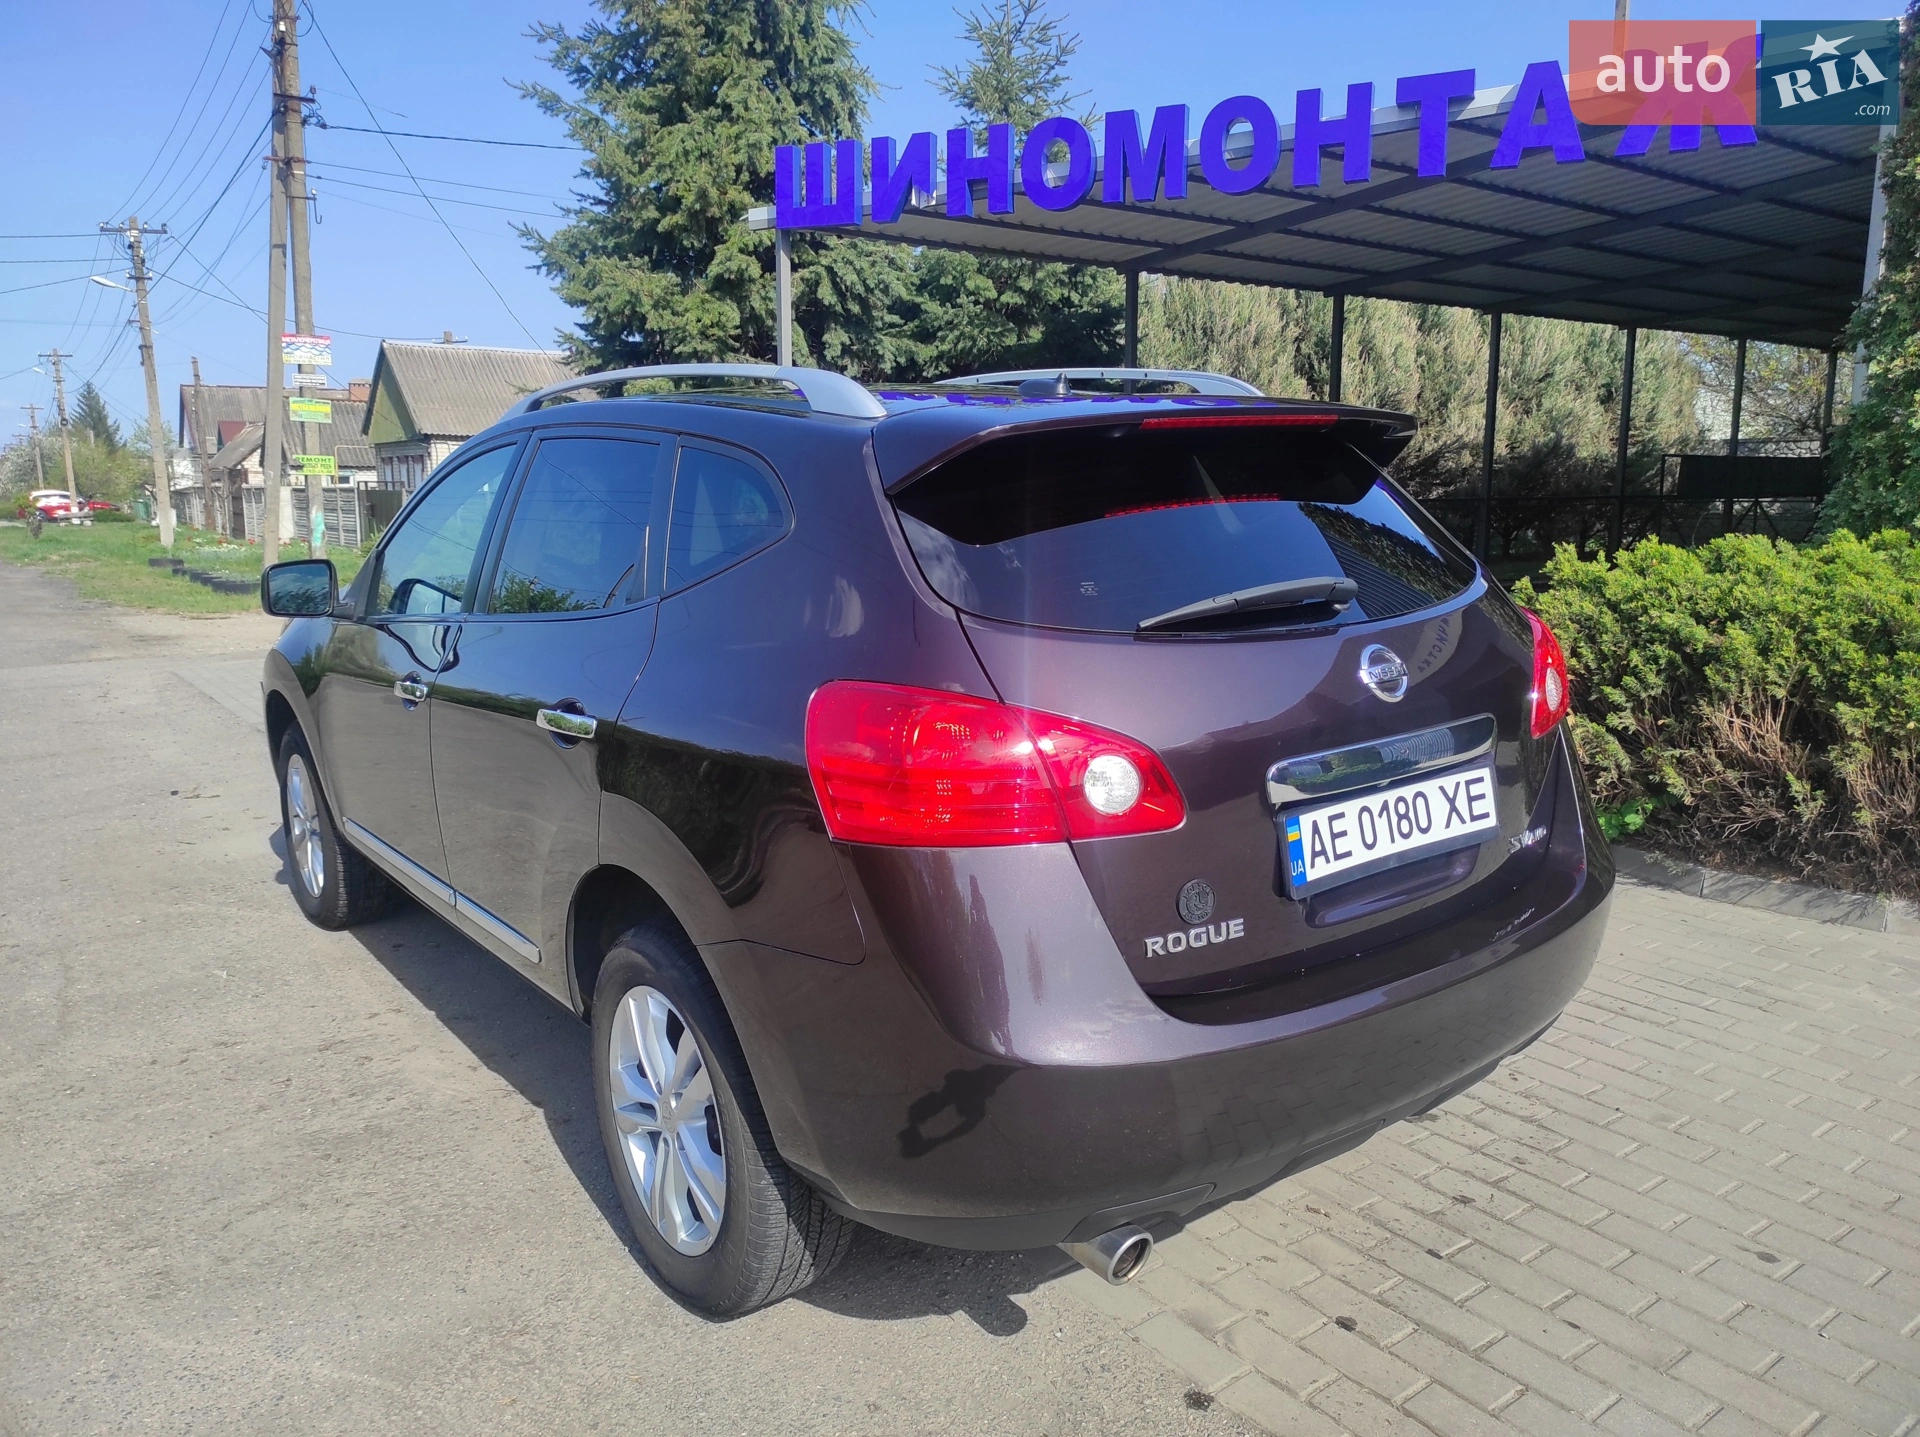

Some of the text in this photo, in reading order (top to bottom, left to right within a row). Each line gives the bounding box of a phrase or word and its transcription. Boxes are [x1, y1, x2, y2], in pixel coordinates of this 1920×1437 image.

[774, 33, 1765, 229] ШИНОМОНТАЖ
[1309, 775, 1491, 870] AE 0180 XE
[1291, 858, 1304, 878] UA
[1144, 917, 1245, 959] ROGUE
